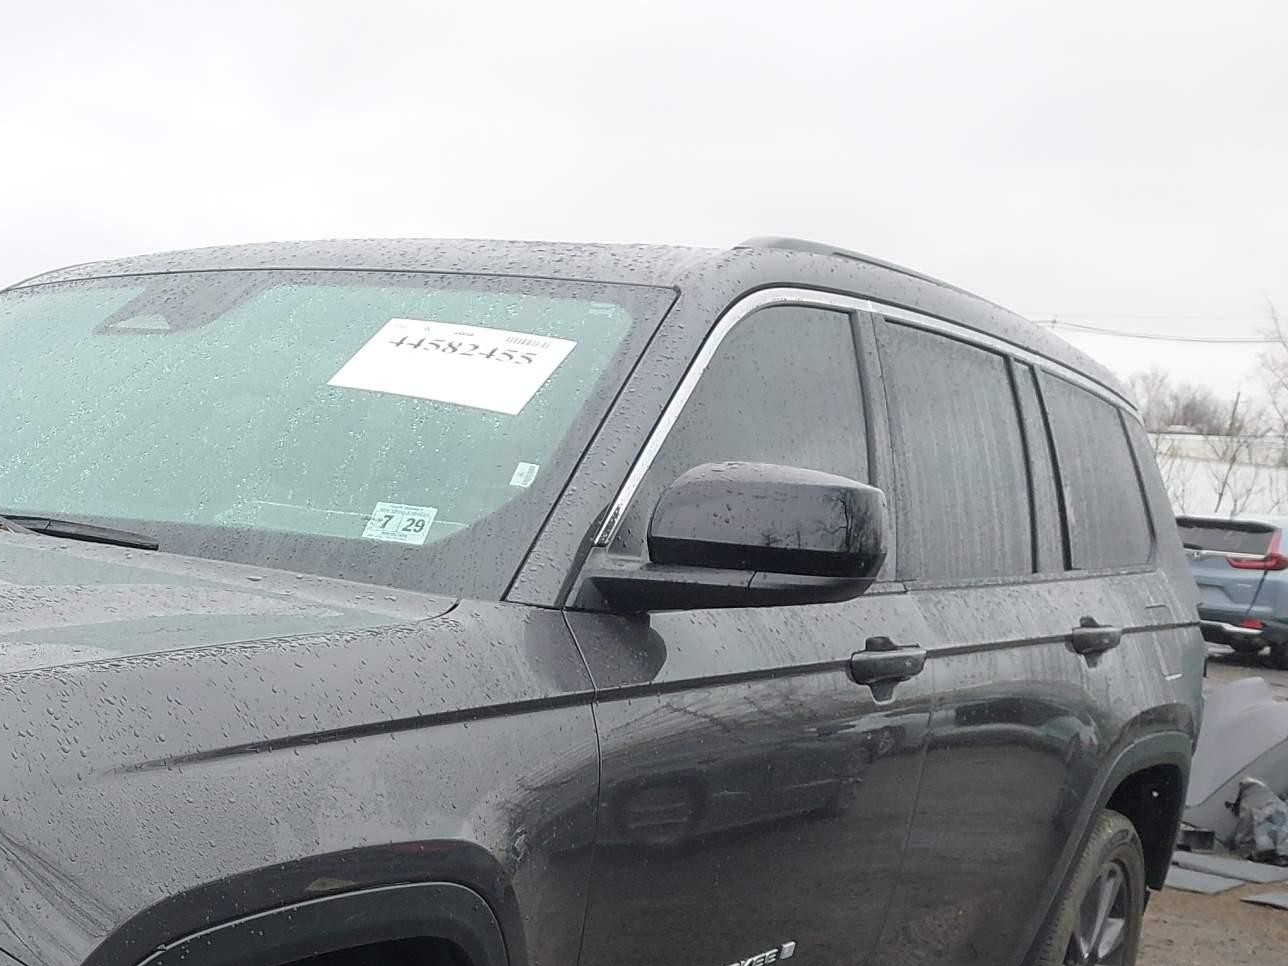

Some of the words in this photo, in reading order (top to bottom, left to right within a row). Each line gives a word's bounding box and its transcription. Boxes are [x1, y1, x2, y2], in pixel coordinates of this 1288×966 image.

[388, 335, 538, 365] 44582455
[380, 514, 394, 529] 7
[401, 517, 426, 533] 29
